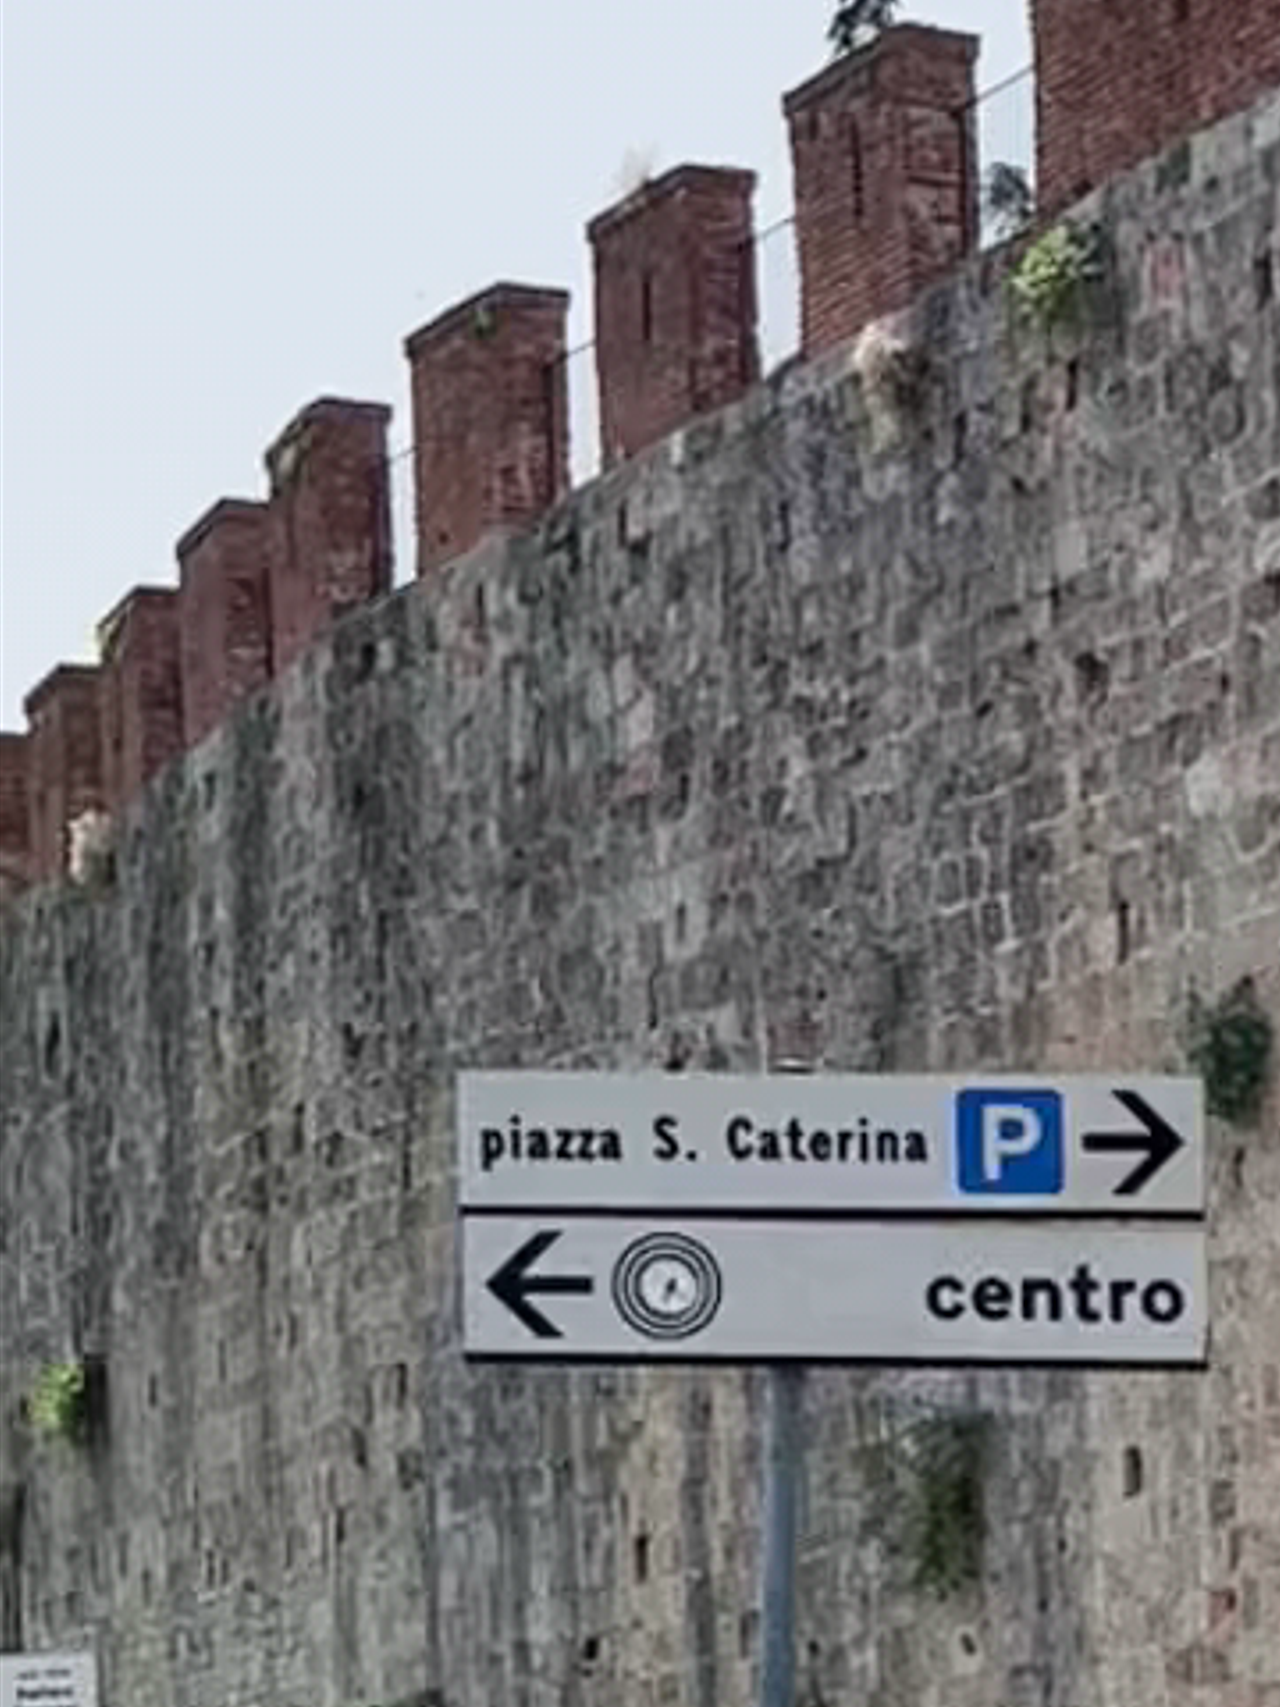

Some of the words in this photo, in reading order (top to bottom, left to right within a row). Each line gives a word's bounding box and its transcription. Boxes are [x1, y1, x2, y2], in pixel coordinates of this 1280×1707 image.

[479, 1113, 623, 1172] piazza
[652, 1115, 698, 1162] S.
[725, 1115, 929, 1163] Caterina
[982, 1103, 1043, 1181] P
[924, 1263, 1186, 1325] centro
